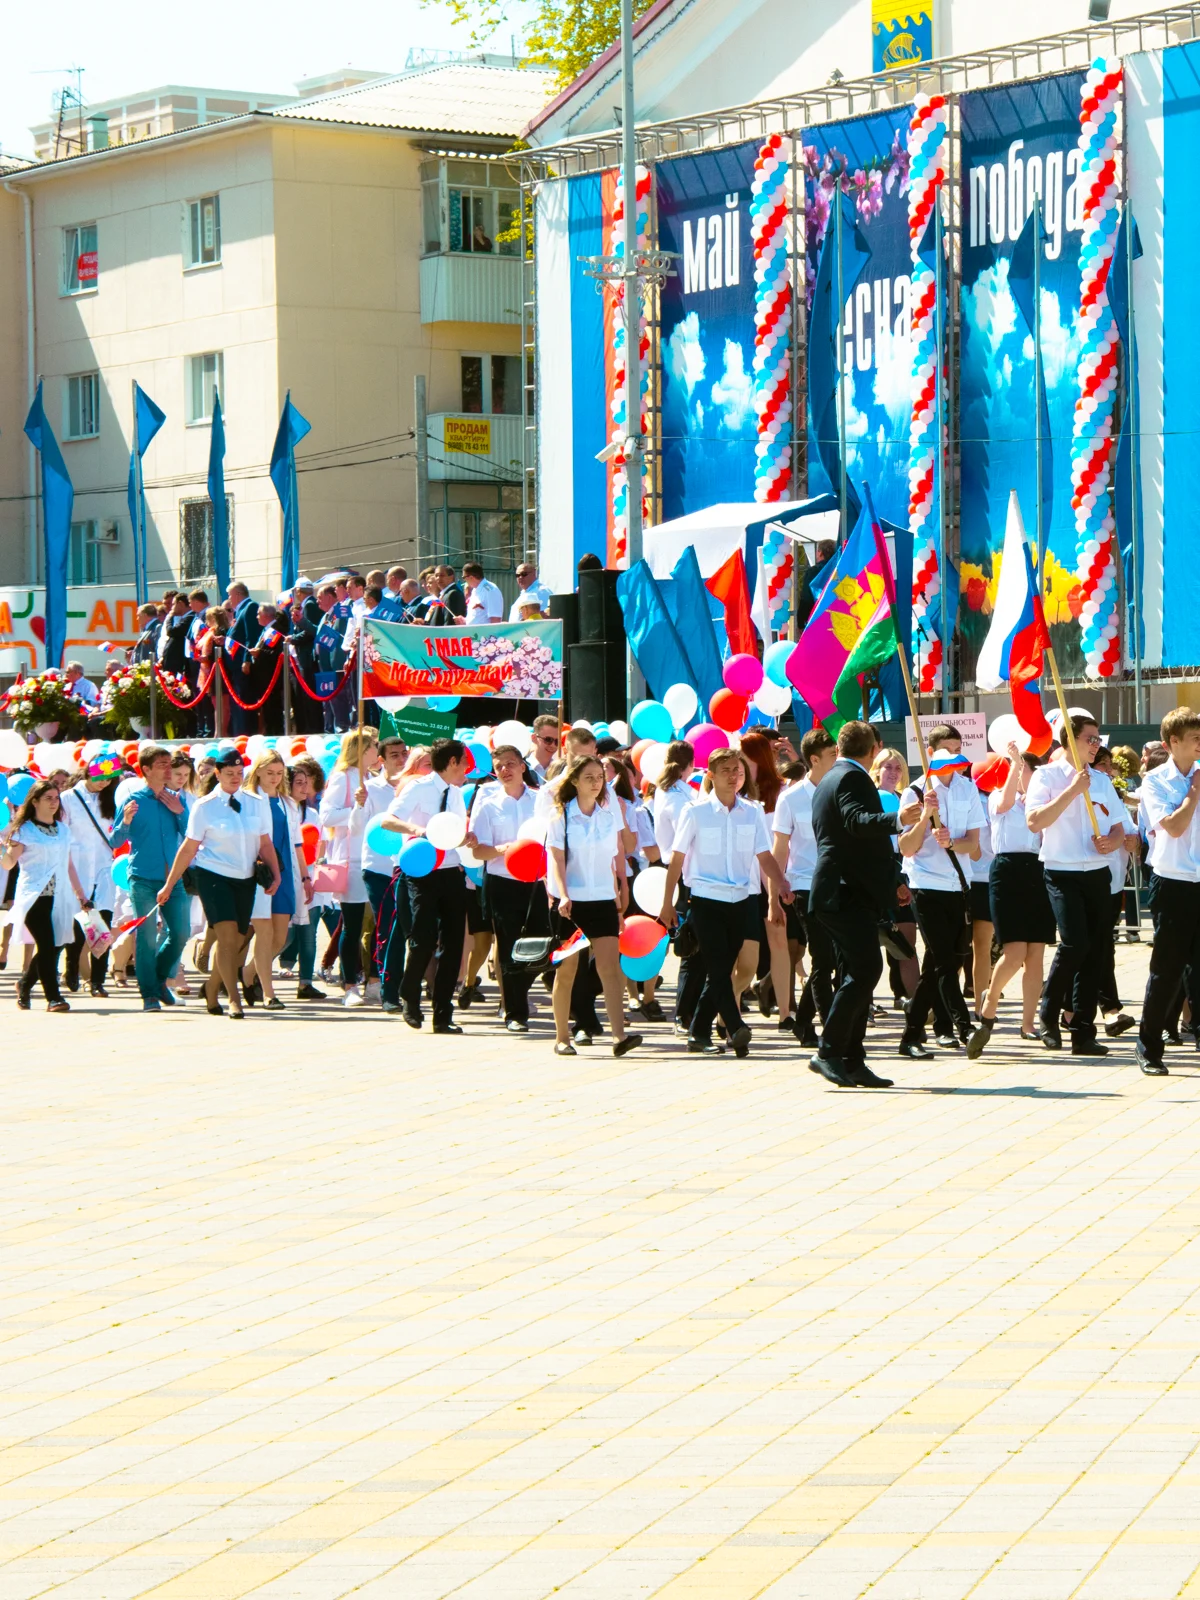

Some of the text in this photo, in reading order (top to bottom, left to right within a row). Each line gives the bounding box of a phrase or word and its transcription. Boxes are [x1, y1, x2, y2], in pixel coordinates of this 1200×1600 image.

[969, 138, 1085, 260] победа
[836, 275, 913, 373] есна
[446, 422, 488, 435] ПРОДАМ
[450, 434, 486, 443] КВАРТИРУ
[423, 636, 473, 657] 1 МАЯ
[387, 715, 429, 728] Сециальность
[919, 718, 977, 728] ПЕЦИАЛЬНОСТЬ
